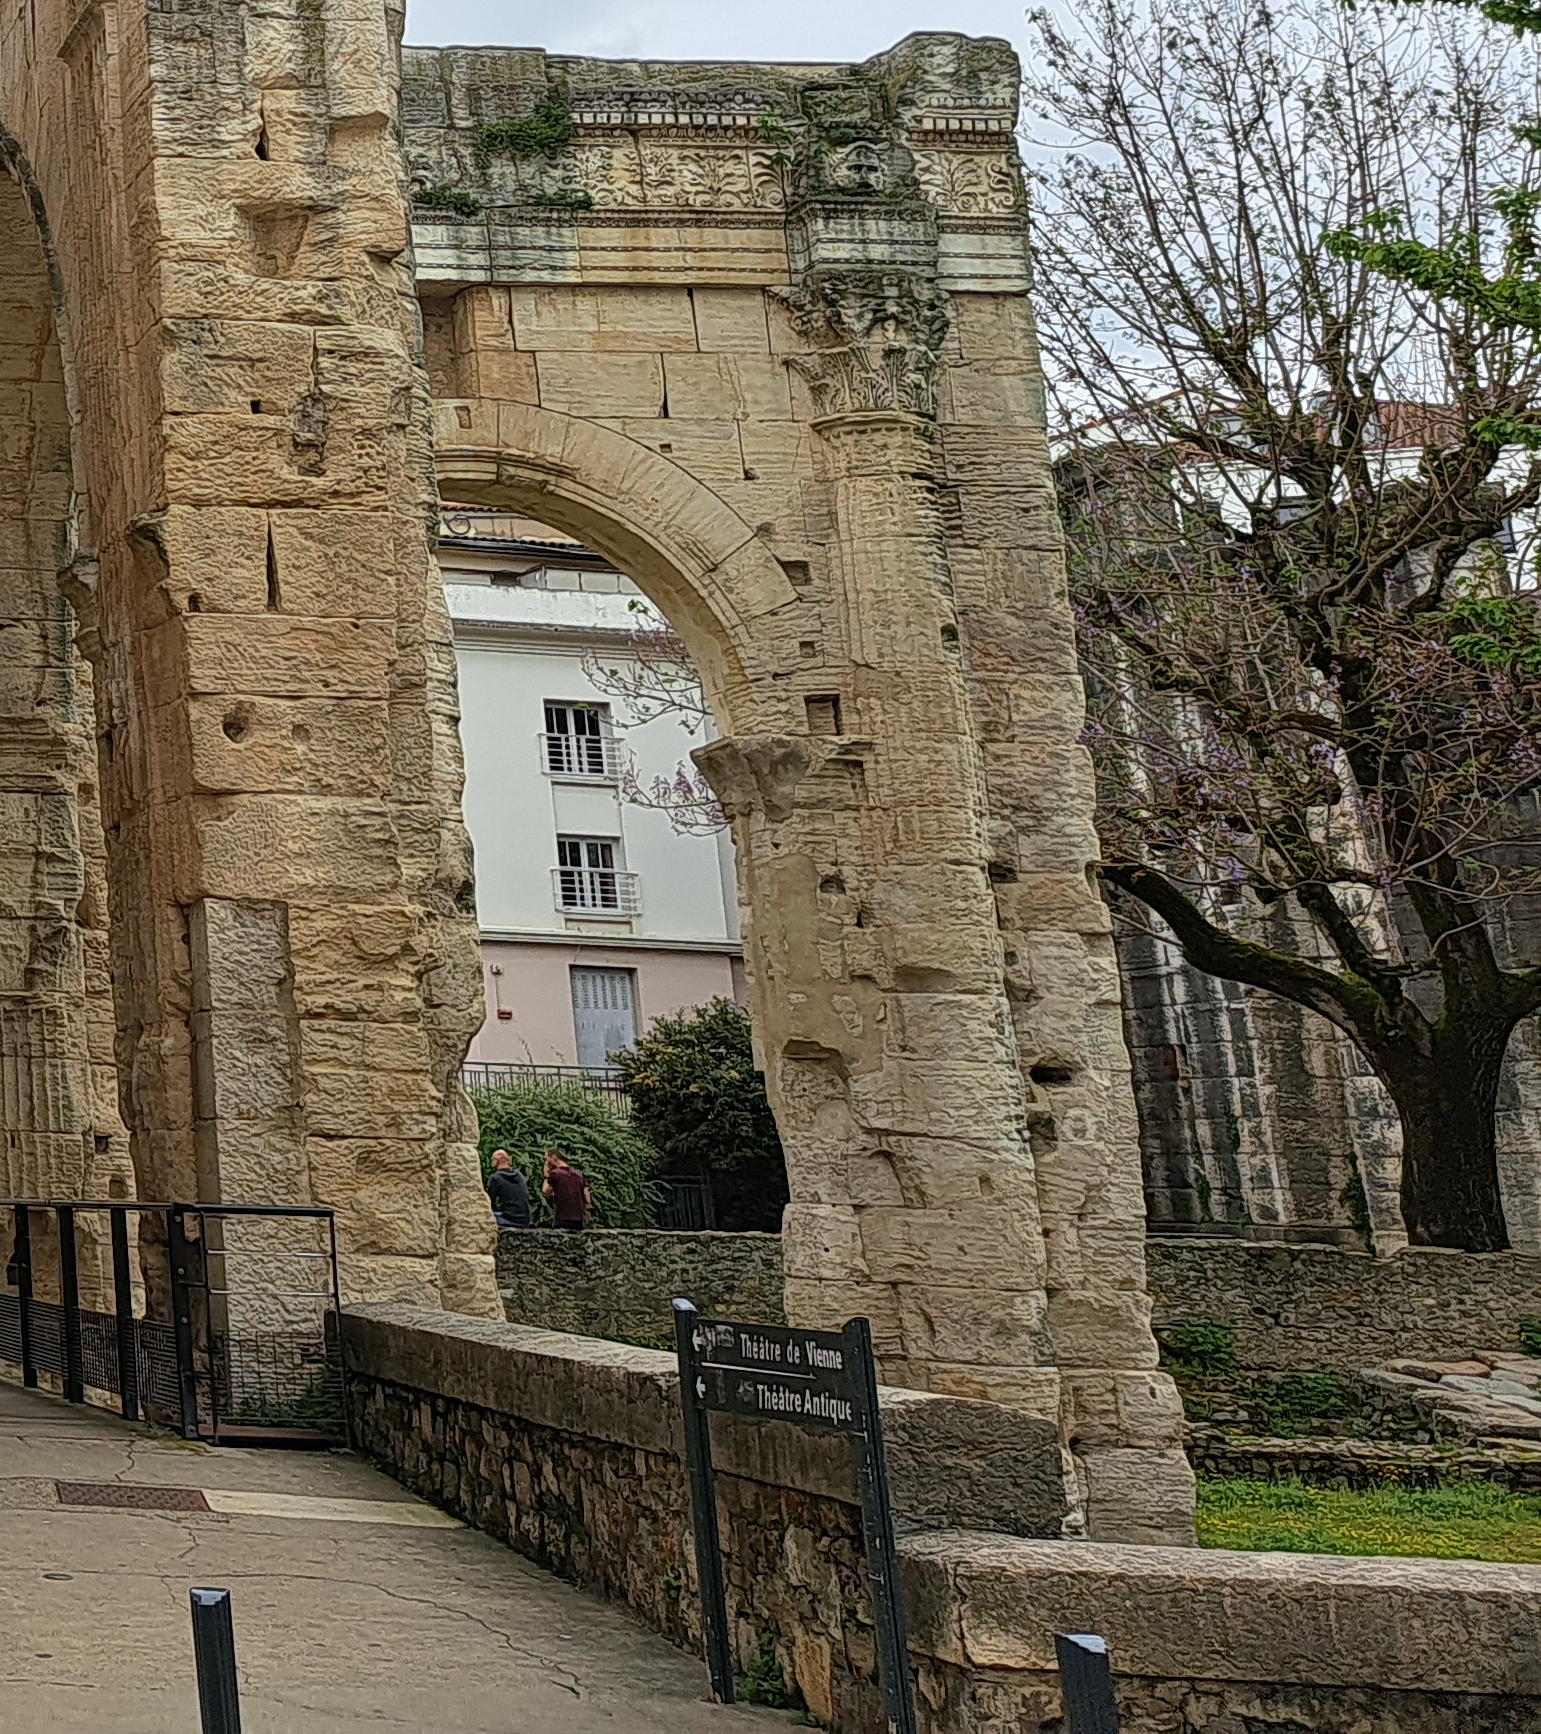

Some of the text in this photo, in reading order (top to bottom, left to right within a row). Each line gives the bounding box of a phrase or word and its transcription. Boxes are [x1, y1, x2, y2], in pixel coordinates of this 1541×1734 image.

[740, 1333, 843, 1370] Théâtre de Vienne
[757, 1383, 852, 1425] Théâtre Antique
